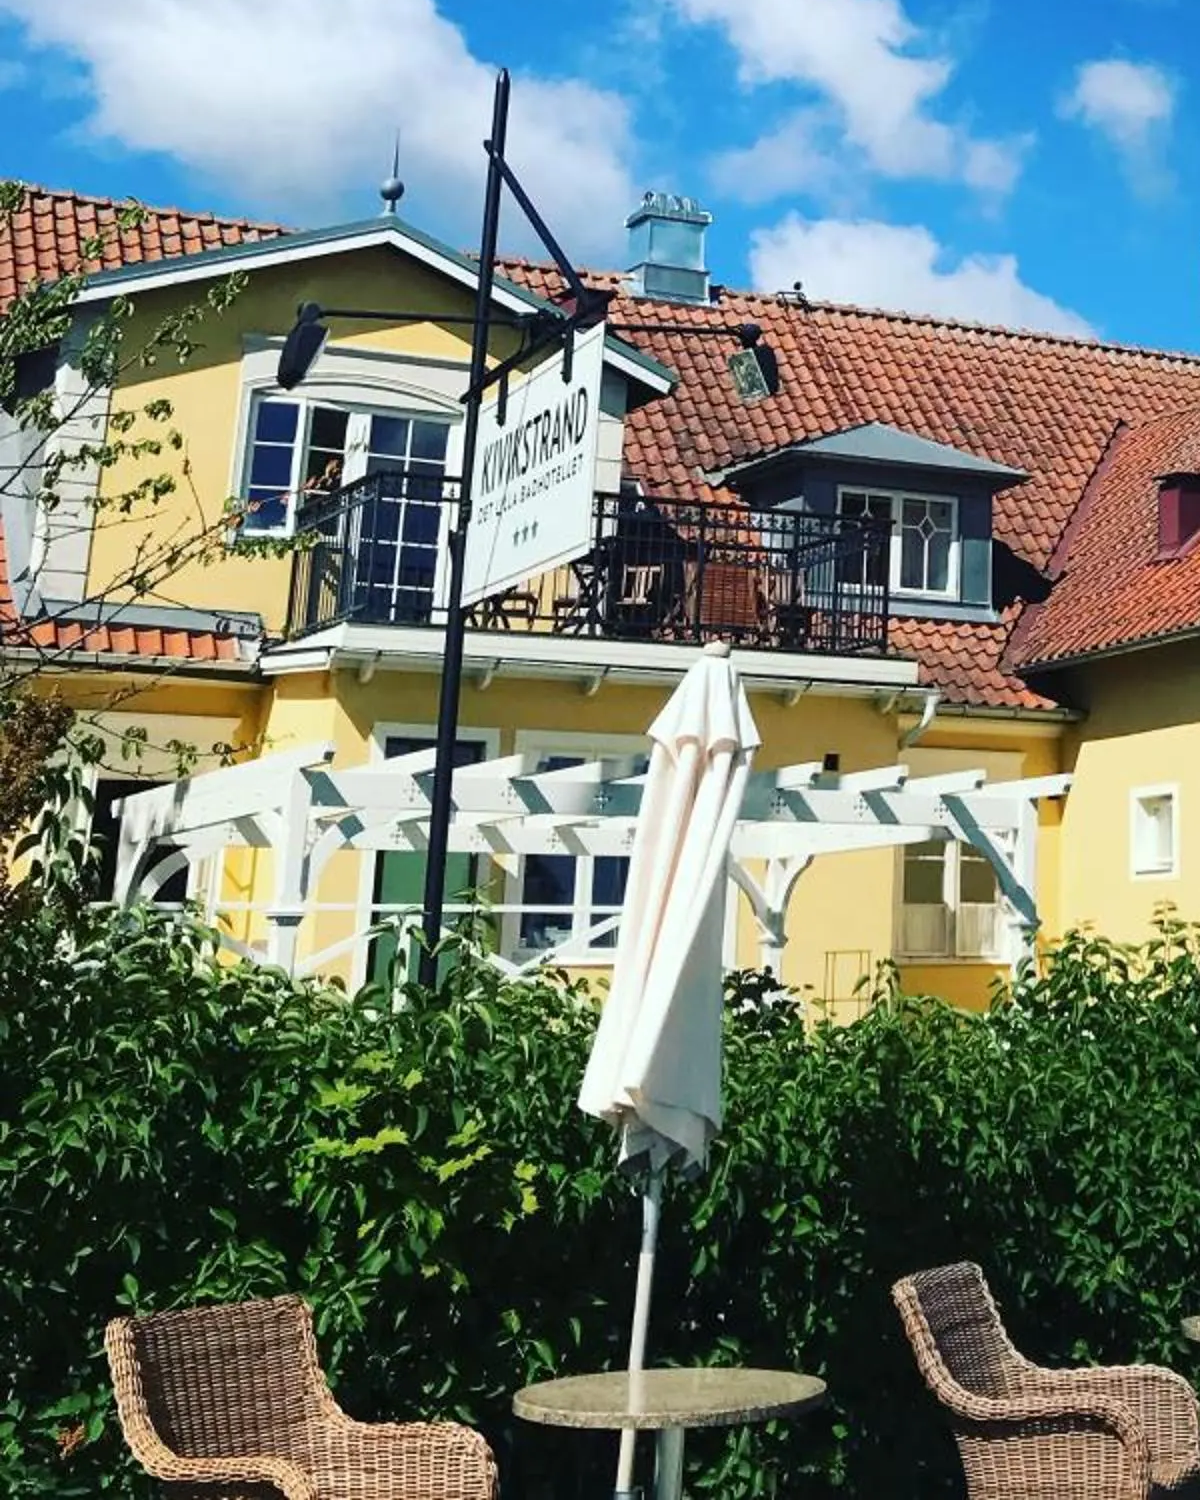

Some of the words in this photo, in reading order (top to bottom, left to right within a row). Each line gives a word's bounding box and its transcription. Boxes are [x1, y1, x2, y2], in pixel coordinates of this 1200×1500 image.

[480, 387, 588, 497] KIVIKSTRAND
[477, 501, 494, 524] DET
[520, 453, 583, 505] BADHOTELLET
